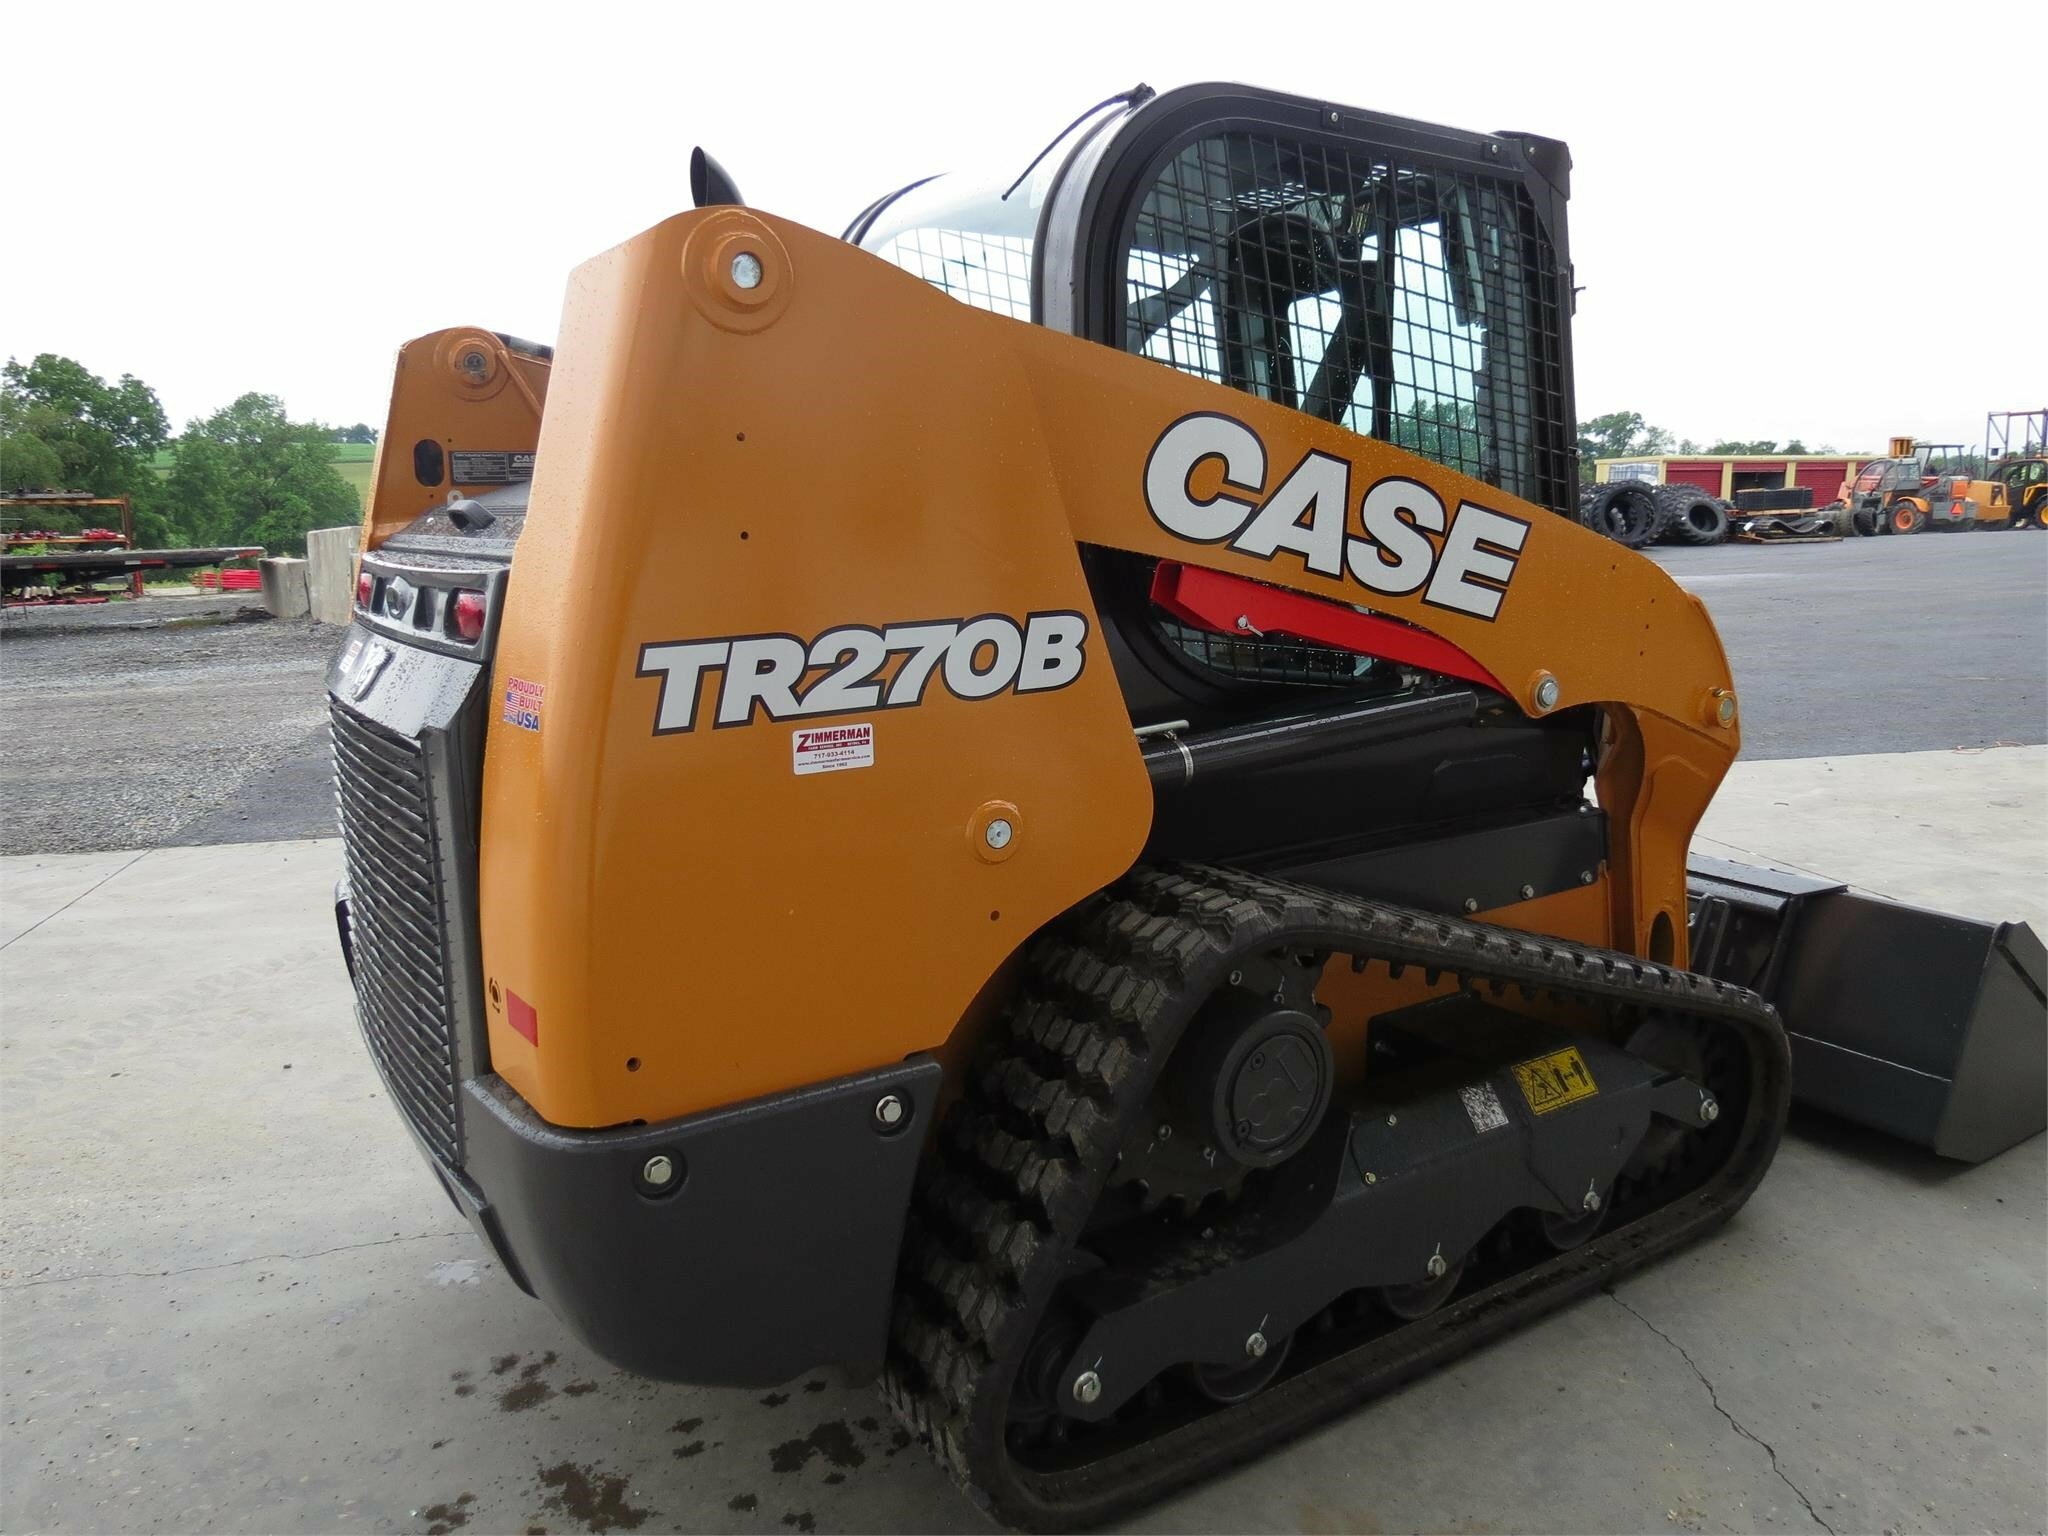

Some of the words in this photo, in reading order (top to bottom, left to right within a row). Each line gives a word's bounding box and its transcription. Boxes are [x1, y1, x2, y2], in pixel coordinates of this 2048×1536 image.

[513, 455, 536, 463] CAS
[1143, 411, 1532, 623] CASE
[635, 609, 1089, 736] TR270B
[508, 677, 545, 697] PROUDLY
[519, 695, 543, 712] BUILT
[517, 710, 539, 731] USA
[797, 727, 870, 753] ZIMMERMAN
[813, 749, 855, 760] 717-933-4114
